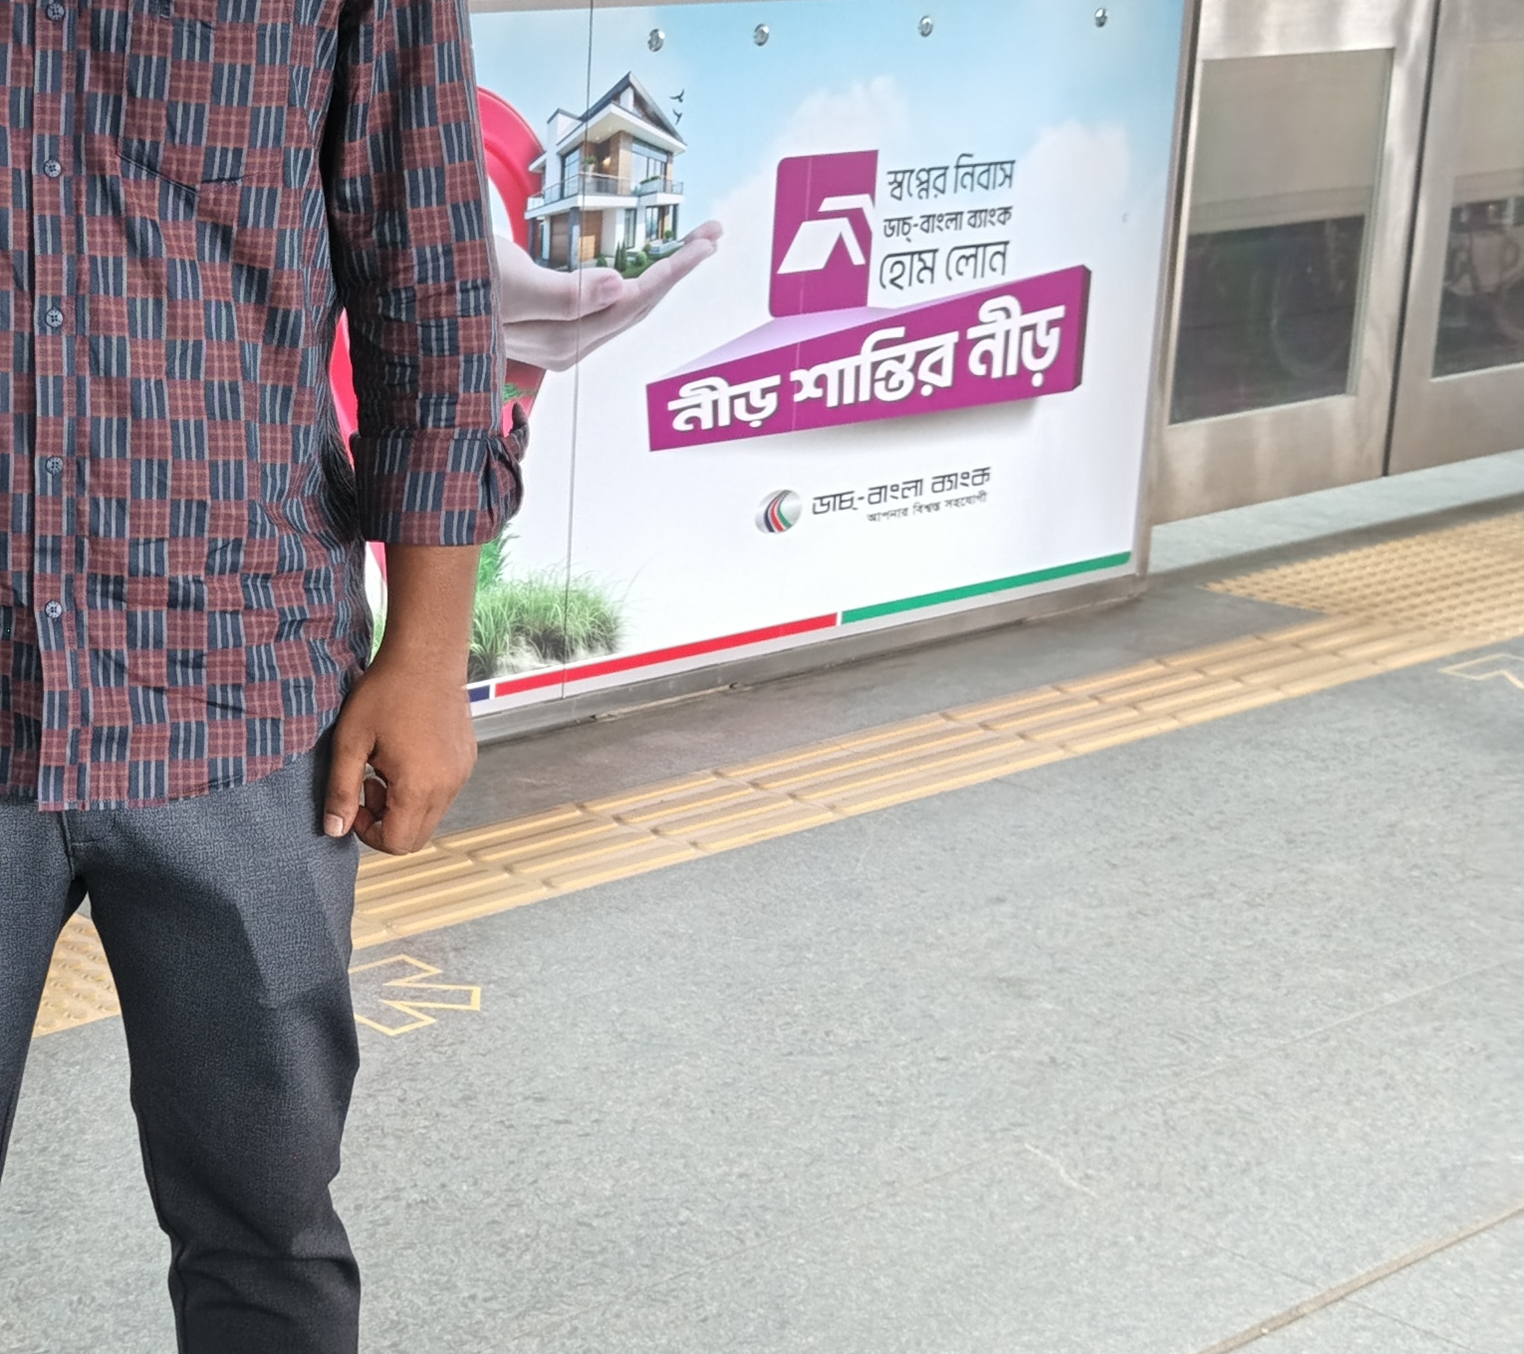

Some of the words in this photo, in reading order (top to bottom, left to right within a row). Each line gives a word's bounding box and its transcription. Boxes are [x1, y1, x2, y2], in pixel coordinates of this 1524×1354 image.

[886, 165, 950, 201] স্বপ্নের
[953, 153, 1017, 194] নিবাস
[882, 211, 965, 243] ডাচ্-বাংলা
[966, 205, 1014, 229] ব্যাংক
[878, 248, 939, 291] হোম
[944, 240, 1011, 281] লোন
[789, 326, 959, 409] শান্তির
[812, 478, 924, 516] ডাচ্-বাংলা
[931, 466, 992, 494] ব্যাংক
